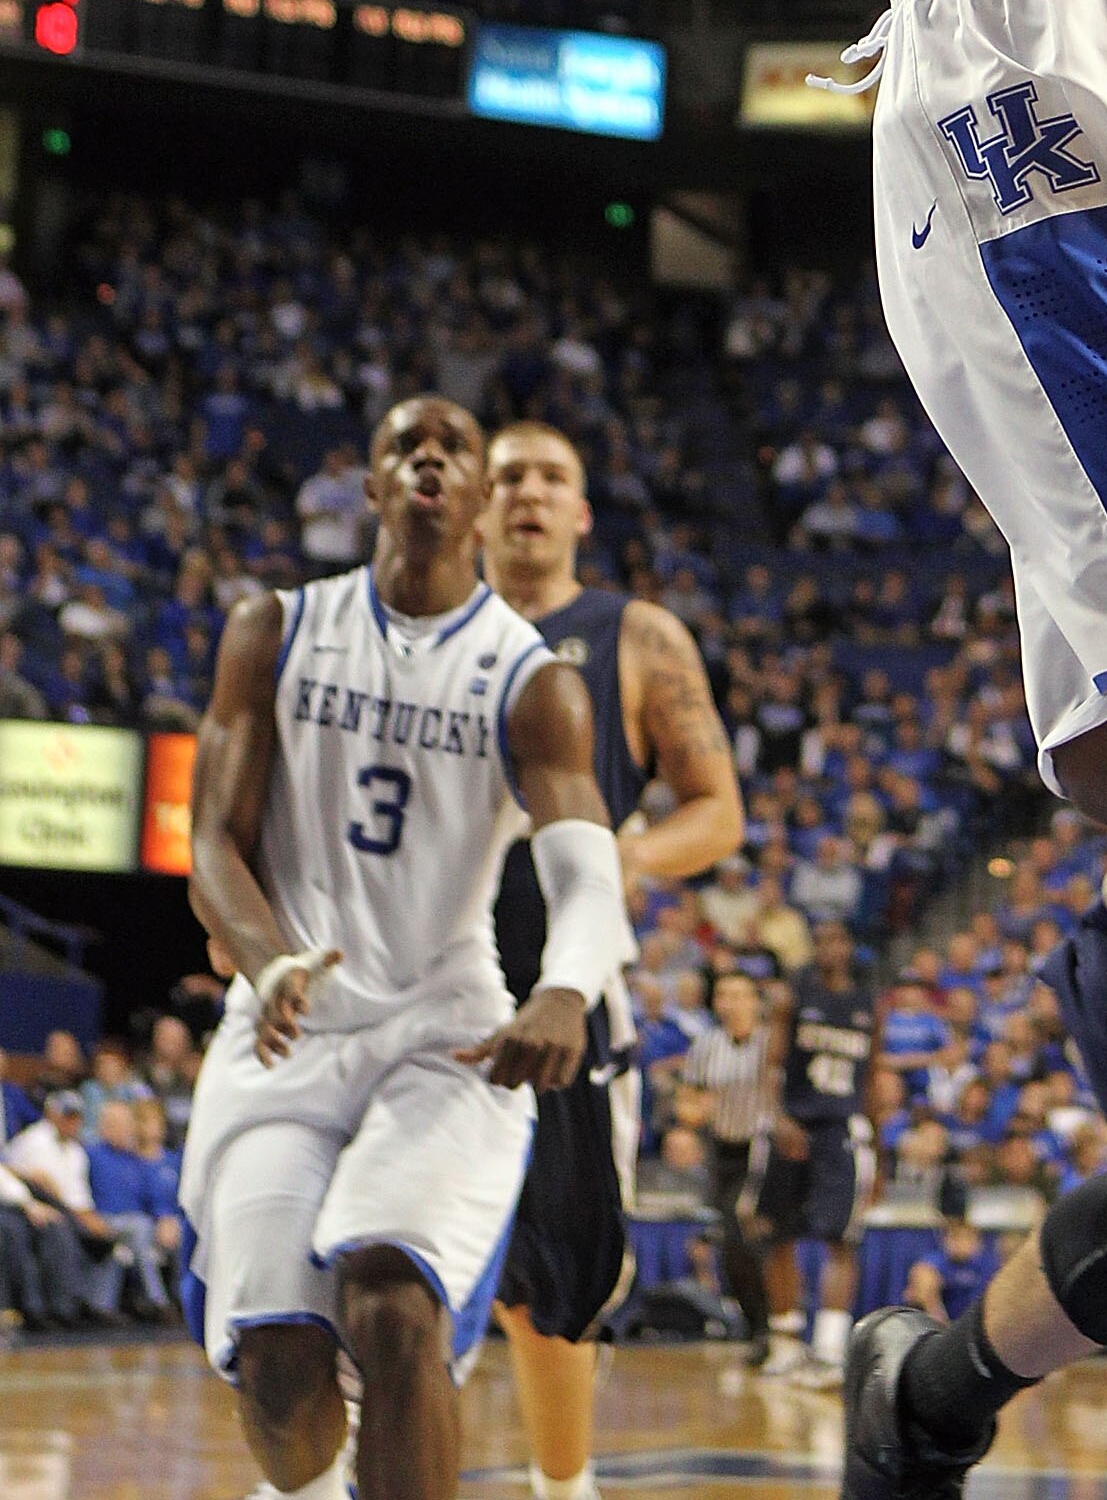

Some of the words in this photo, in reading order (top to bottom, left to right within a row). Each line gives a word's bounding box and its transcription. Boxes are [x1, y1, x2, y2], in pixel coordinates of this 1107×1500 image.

[937, 80, 1101, 216] UK
[294, 677, 490, 758] KENTUCKY
[347, 765, 412, 856] 3
